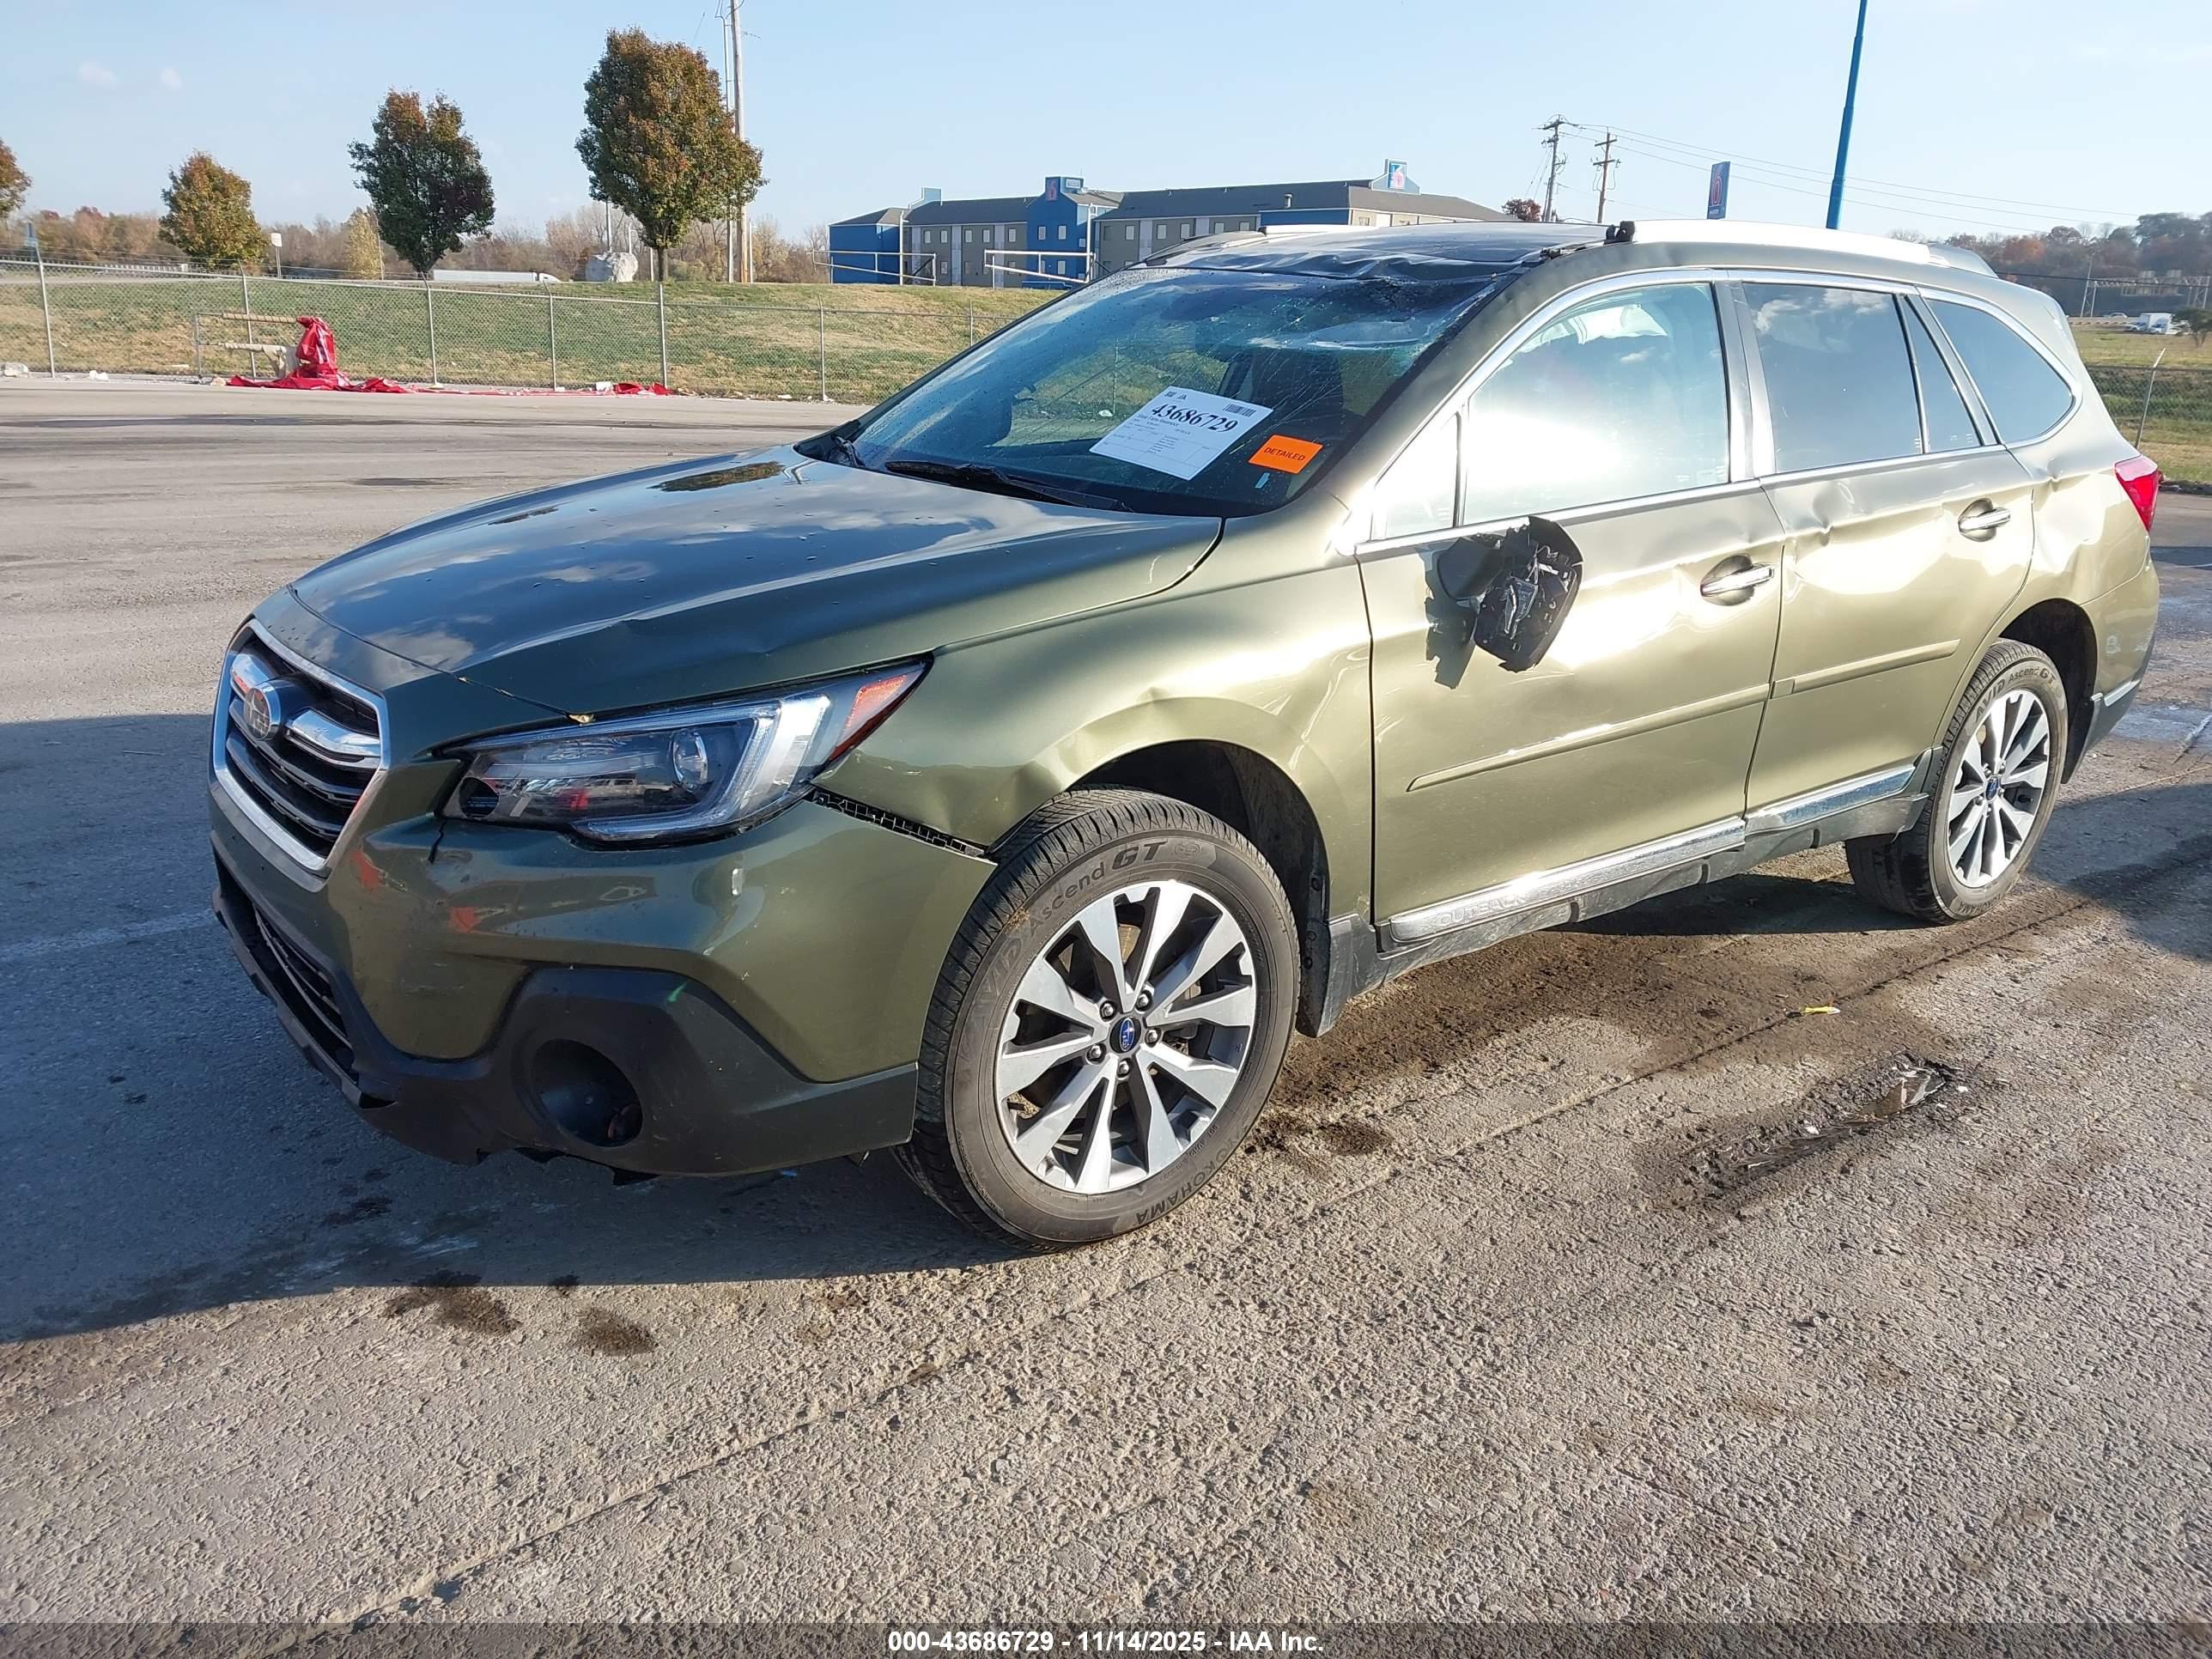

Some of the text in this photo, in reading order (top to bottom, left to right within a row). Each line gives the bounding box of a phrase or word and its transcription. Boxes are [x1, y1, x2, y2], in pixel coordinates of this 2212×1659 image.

[1152, 404, 1238, 433] 43686729
[1263, 447, 1306, 461] DETAILED
[2039, 667, 2057, 685] GT
[1030, 861, 1105, 937] Ascend
[1111, 841, 1169, 871] GT
[1135, 1136, 1238, 1224] YOKOHAMA
